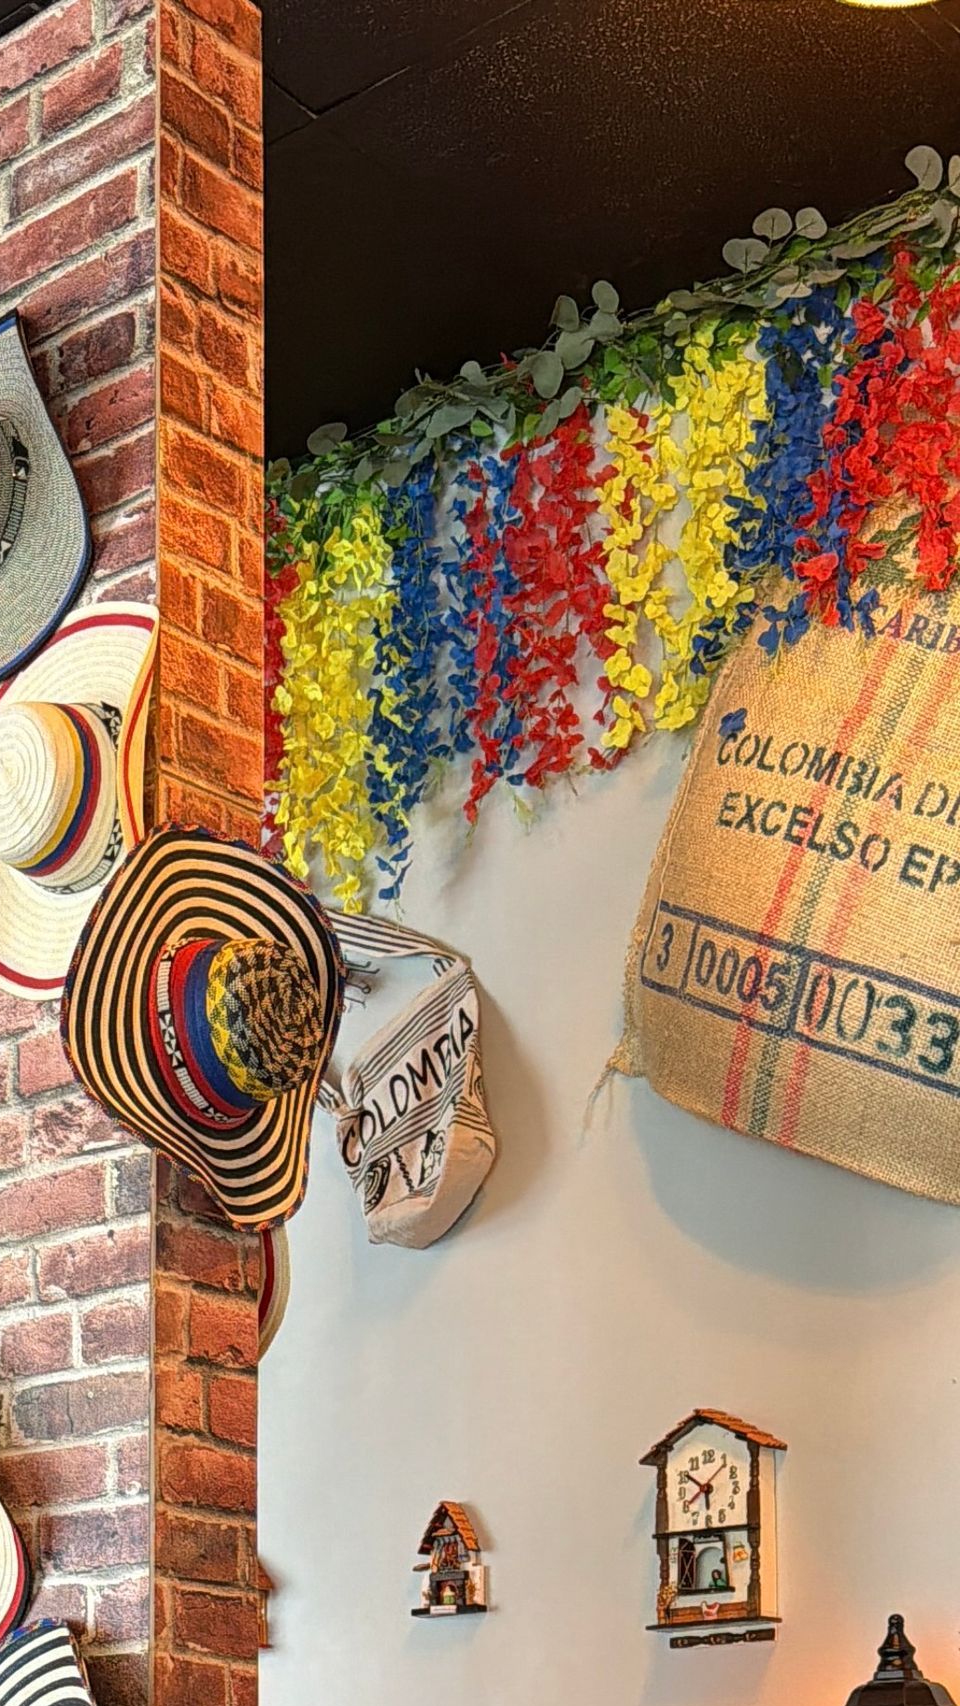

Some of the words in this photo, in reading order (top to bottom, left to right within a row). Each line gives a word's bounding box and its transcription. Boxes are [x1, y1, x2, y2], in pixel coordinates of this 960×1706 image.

[716, 732, 903, 813] COLOMBIA
[716, 790, 892, 873] EXCELSO
[655, 922, 674, 971] 3
[695, 939, 791, 1011] 0005
[342, 1007, 474, 1169] COLOMBIA
[701, 1449, 716, 1465] 12
